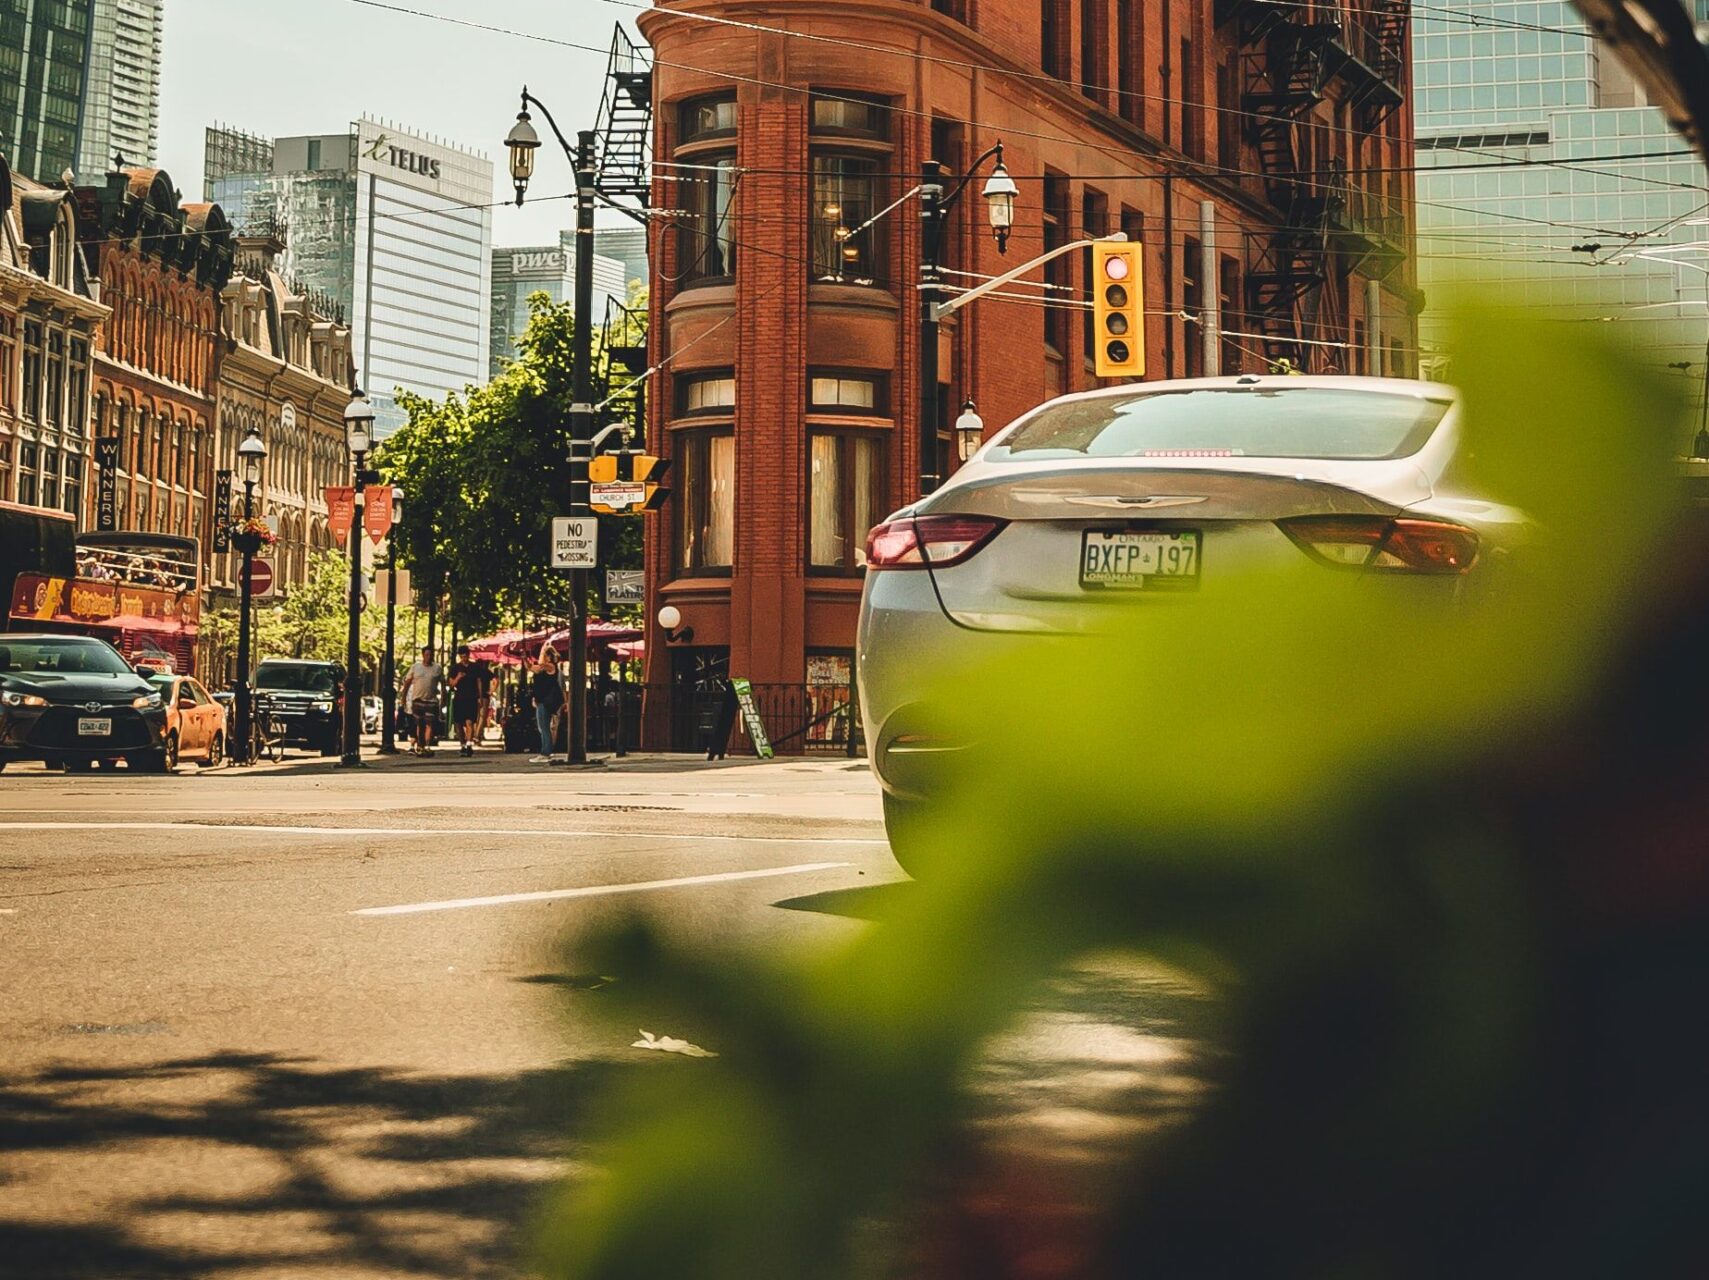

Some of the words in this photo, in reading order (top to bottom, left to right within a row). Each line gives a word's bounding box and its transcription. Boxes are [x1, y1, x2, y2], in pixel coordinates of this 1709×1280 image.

[389, 145, 440, 179] TELUS
[511, 252, 560, 274] pwc
[102, 445, 117, 525] WINNERS
[567, 523, 583, 537] NO
[1119, 535, 1165, 543] ONTARIO
[1087, 545, 1140, 573] BXFP
[1155, 546, 1193, 575] 197
